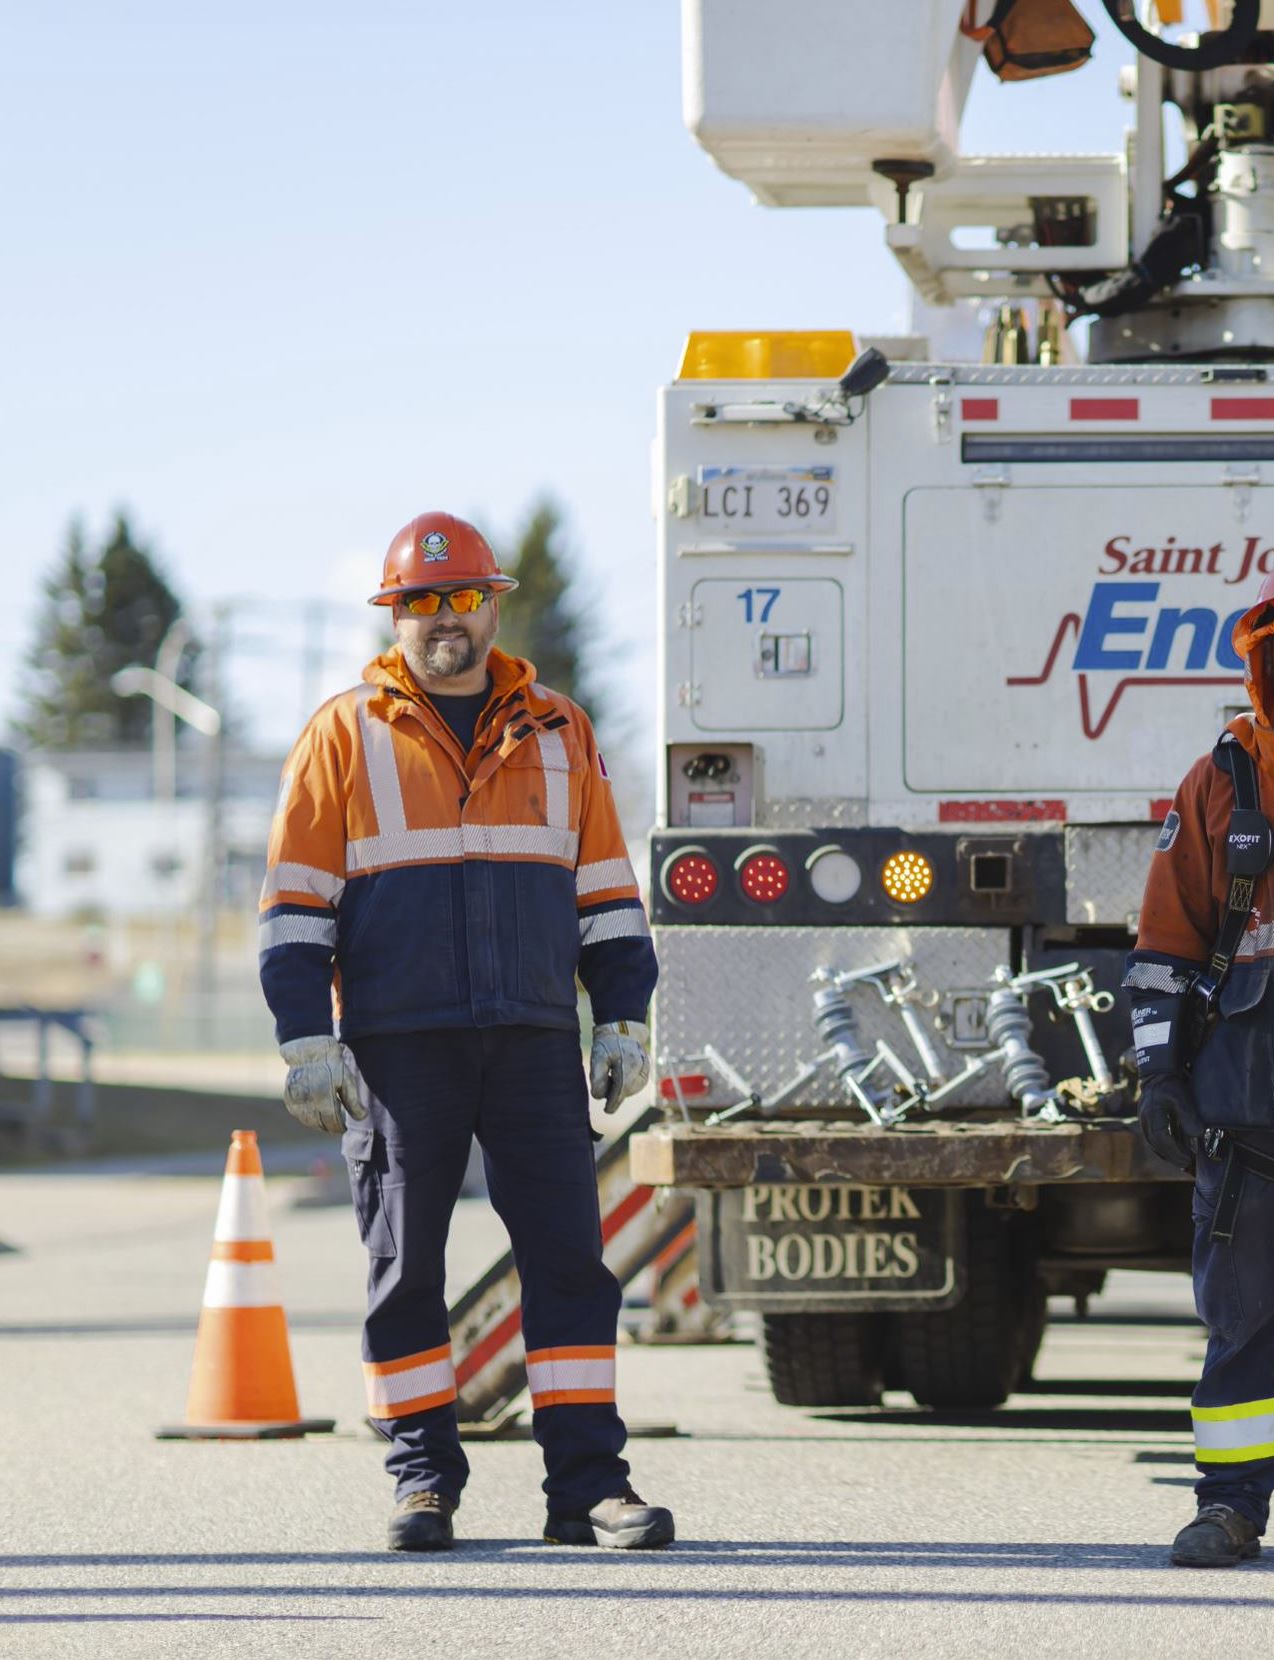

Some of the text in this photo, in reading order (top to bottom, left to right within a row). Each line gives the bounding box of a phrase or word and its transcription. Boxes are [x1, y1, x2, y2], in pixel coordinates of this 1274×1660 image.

[703, 485, 830, 518] LCI 369
[1098, 535, 1226, 576] Saint
[737, 588, 781, 623] 17
[1229, 833, 1261, 843] EXOFIT
[747, 1233, 919, 1280] BODIES
